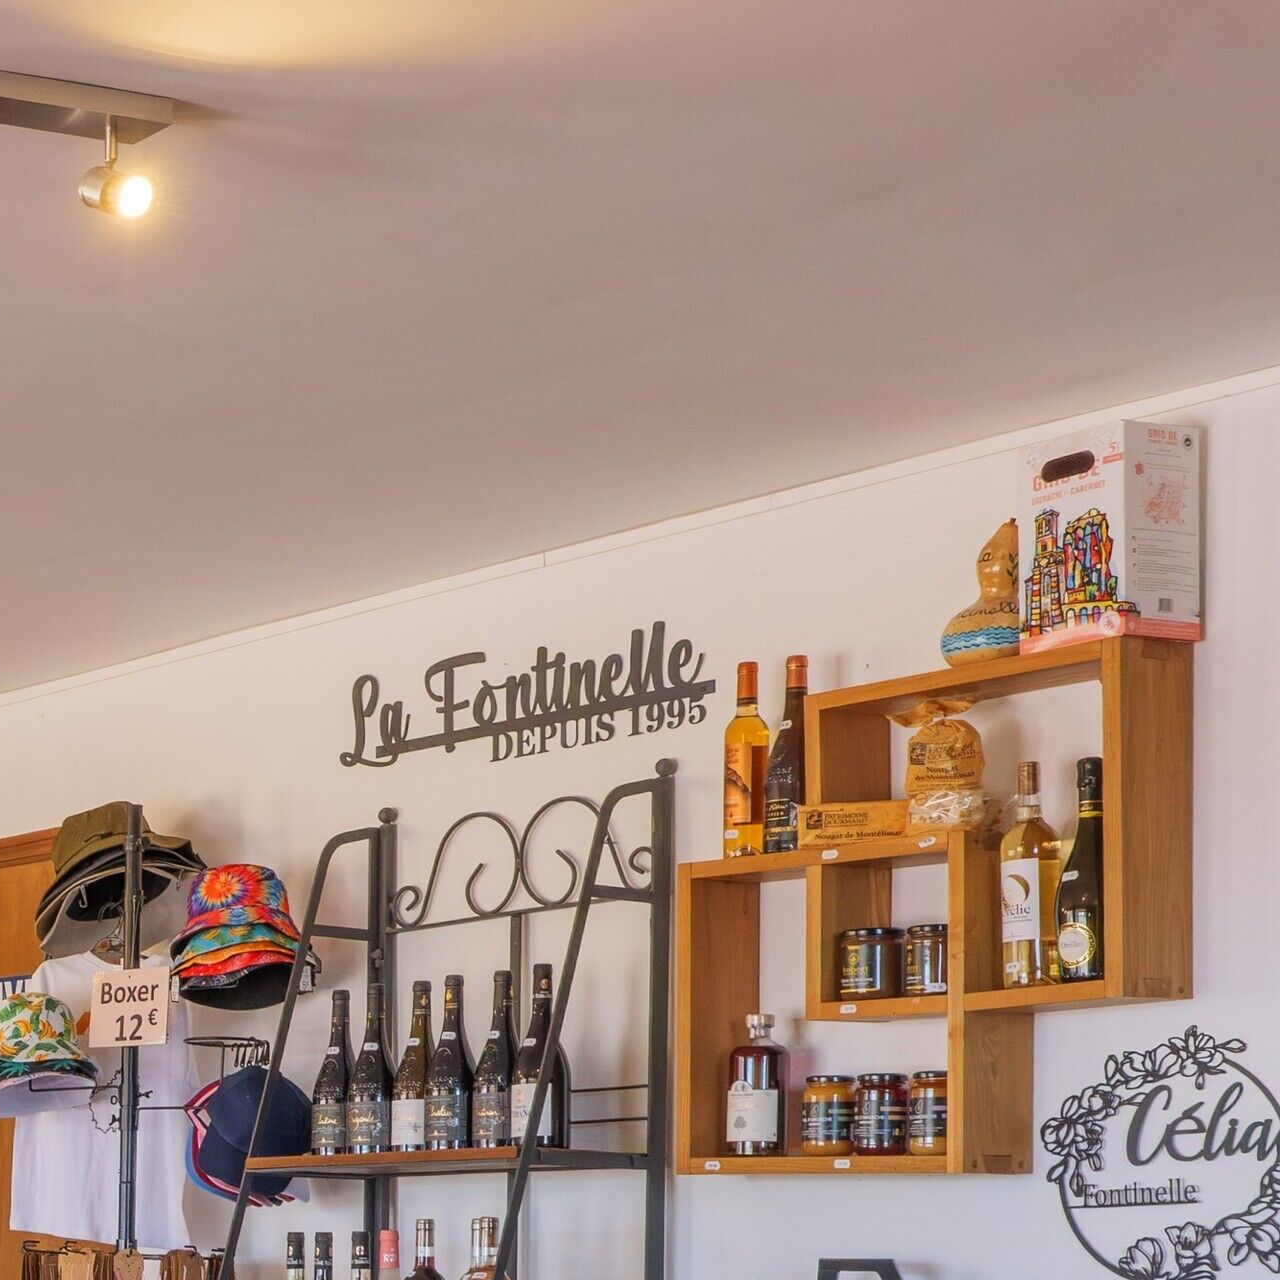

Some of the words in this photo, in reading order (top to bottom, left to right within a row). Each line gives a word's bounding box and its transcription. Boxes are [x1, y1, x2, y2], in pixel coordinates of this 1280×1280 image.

[340, 674, 411, 768] La
[424, 620, 706, 753] Fontinelle
[489, 711, 616, 763] DEPUIS
[627, 699, 708, 737] 1995
[100, 982, 159, 1005] Boxer
[1126, 1081, 1278, 1166] Célia
[1083, 1178, 1198, 1207] Fontinelle
